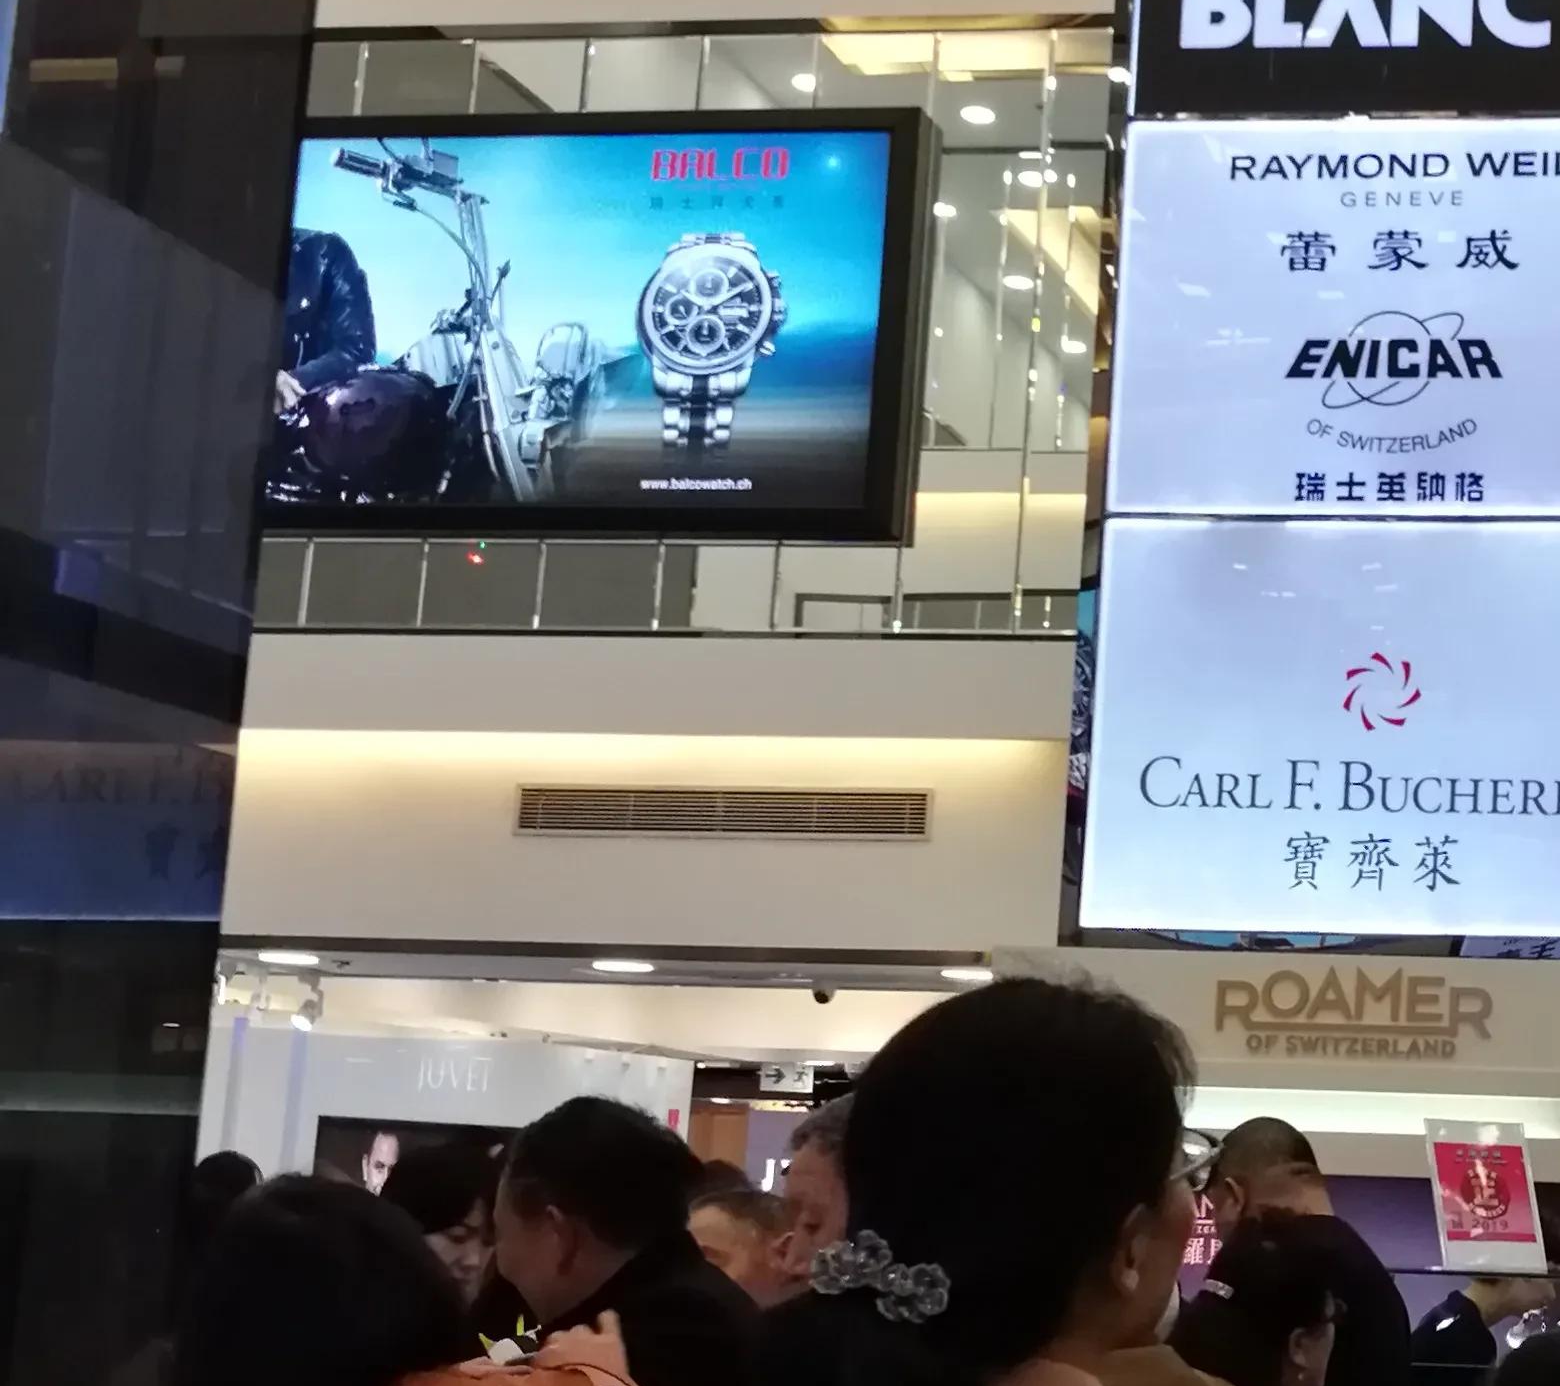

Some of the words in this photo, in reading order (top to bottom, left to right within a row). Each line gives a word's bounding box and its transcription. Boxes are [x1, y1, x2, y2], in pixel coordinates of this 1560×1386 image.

[652, 147, 789, 181] BALCO
[1229, 153, 1450, 181] RAYMOND
[1340, 190, 1463, 208] GENEVE
[1280, 229, 1519, 272] 蕾蒙威
[1285, 338, 1503, 379] ENICAR
[1307, 419, 1334, 438] OF
[1337, 418, 1478, 454] SWITZERLAND
[640, 477, 752, 491] www.balcowatch.ch
[1139, 755, 1272, 809] CARL
[1284, 759, 1322, 811] F.
[1283, 831, 1461, 891] 寶齊萊
[1215, 965, 1493, 1039] ROAMER
[1246, 1034, 1278, 1056] OF
[1286, 1034, 1456, 1060] SWITZERLAND
[418, 1057, 493, 1093] JUVET
